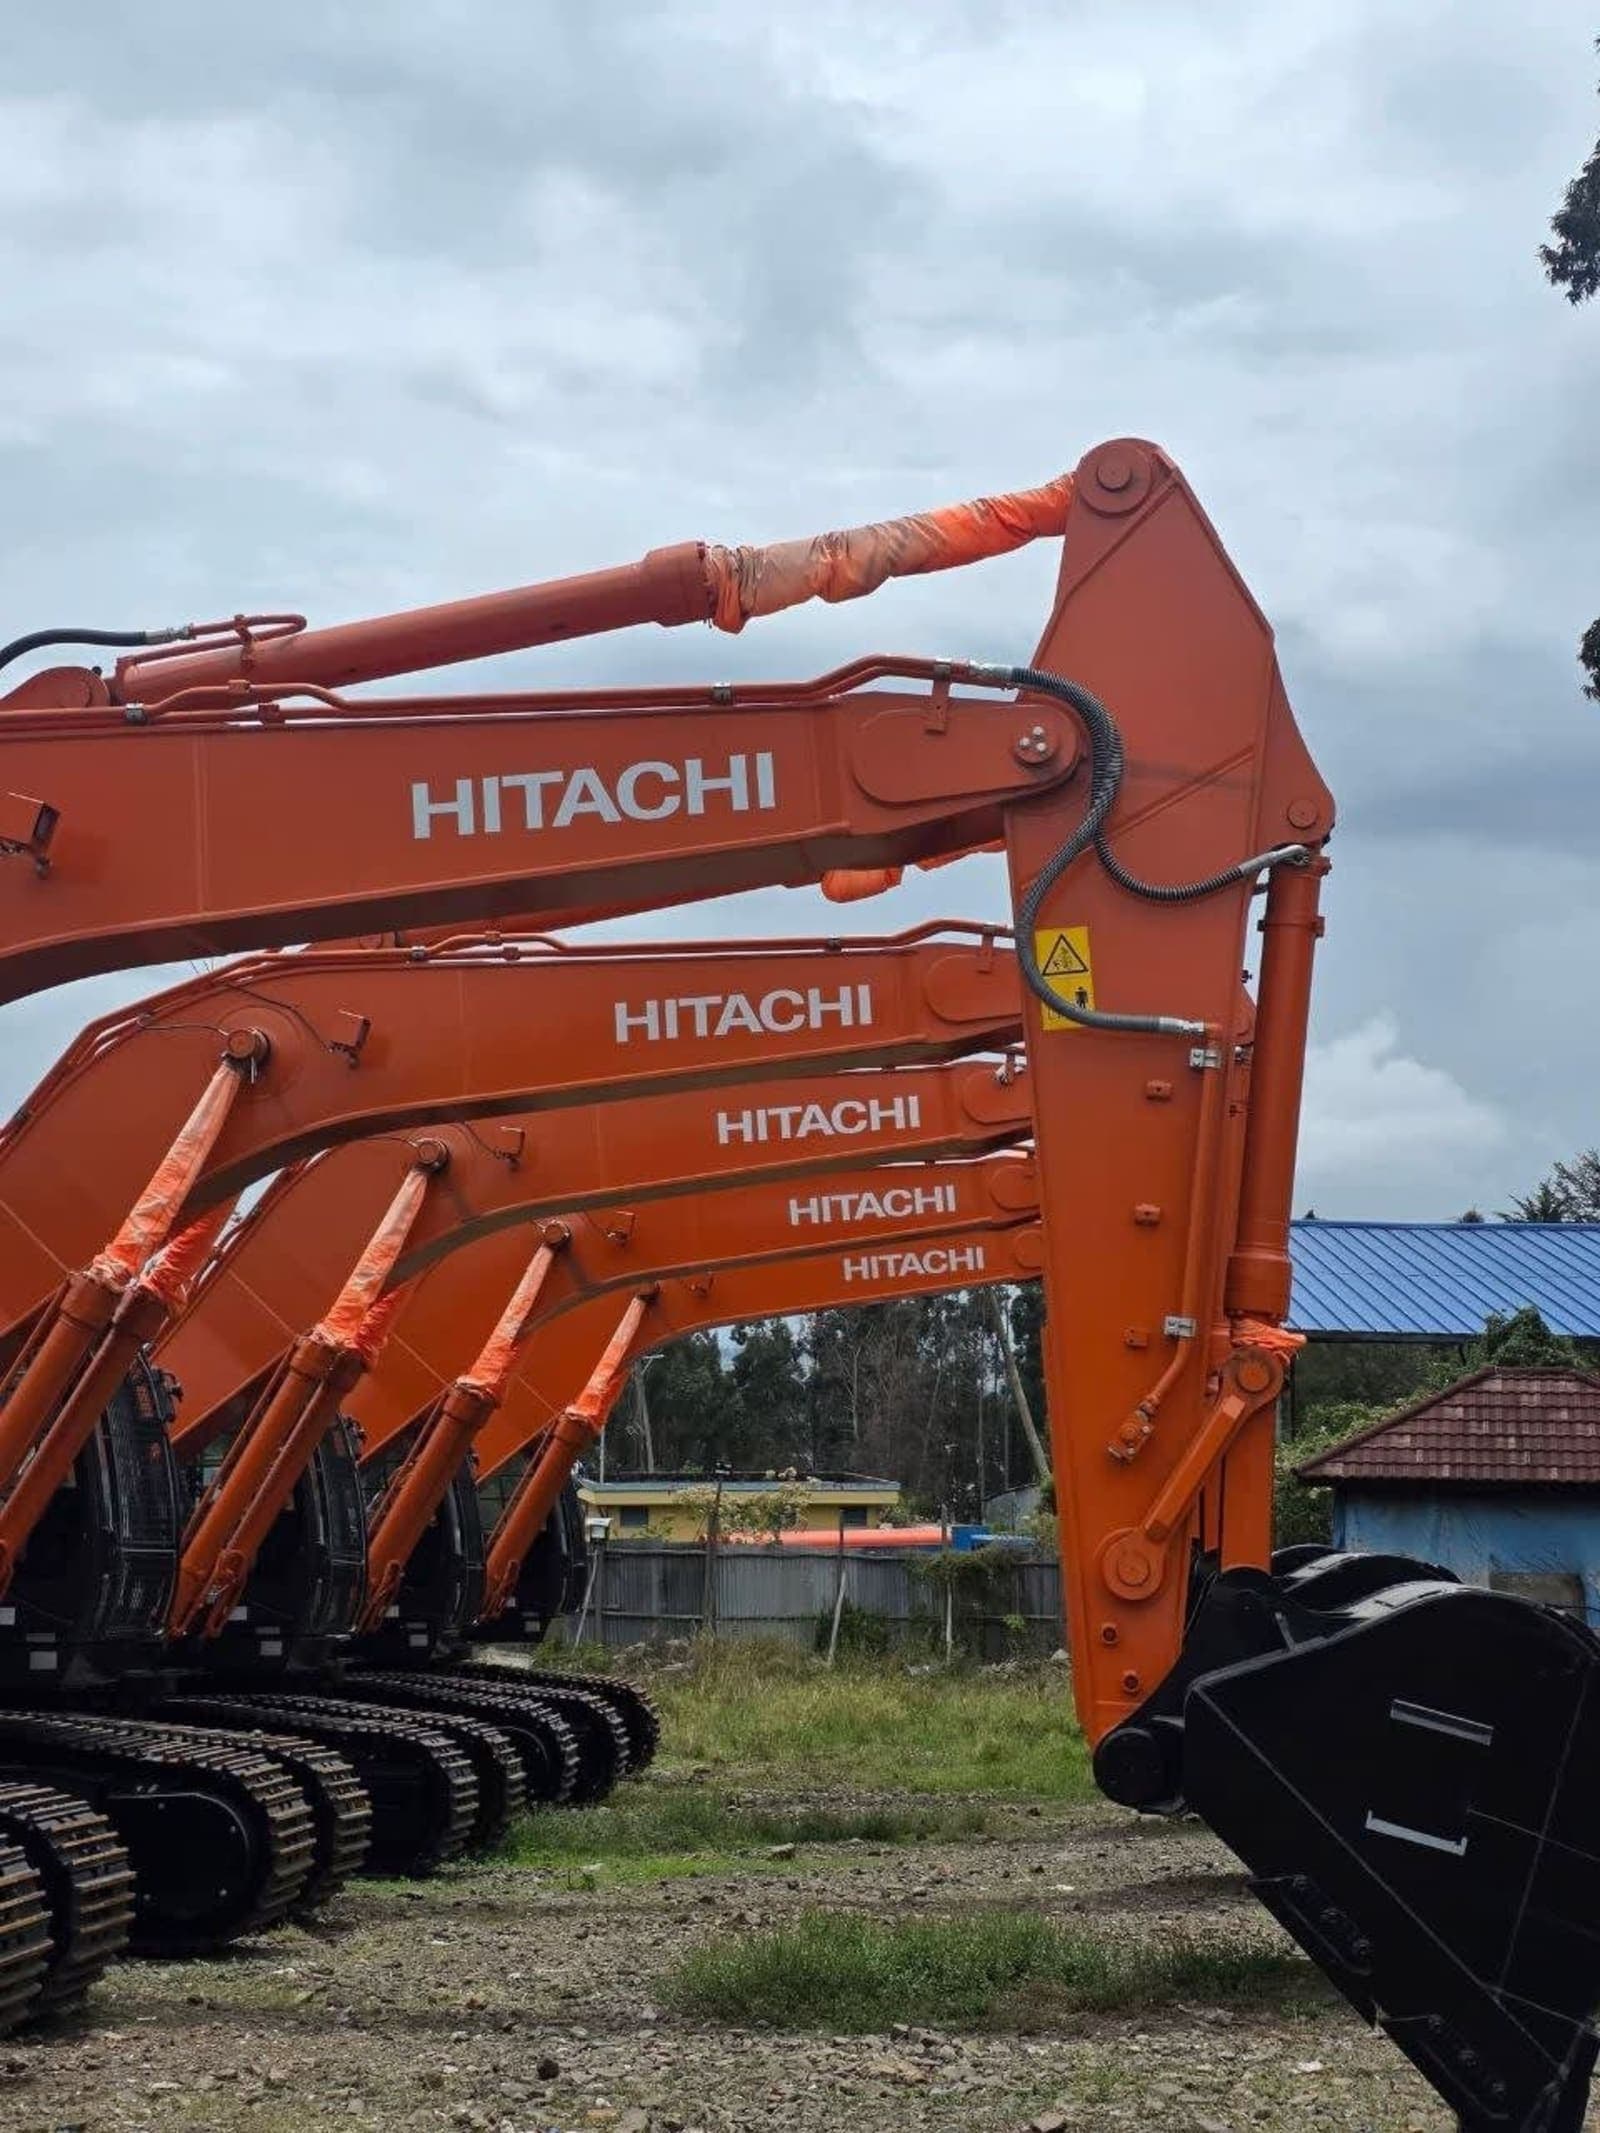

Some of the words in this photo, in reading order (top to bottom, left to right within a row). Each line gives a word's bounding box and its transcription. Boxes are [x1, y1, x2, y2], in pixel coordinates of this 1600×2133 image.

[411, 752, 777, 840] HITACHI
[614, 984, 873, 1043] HITACHI
[717, 1095, 921, 1145] HITACHI
[789, 1185, 957, 1226] HITACHI
[843, 1247, 985, 1283] HITACHI
